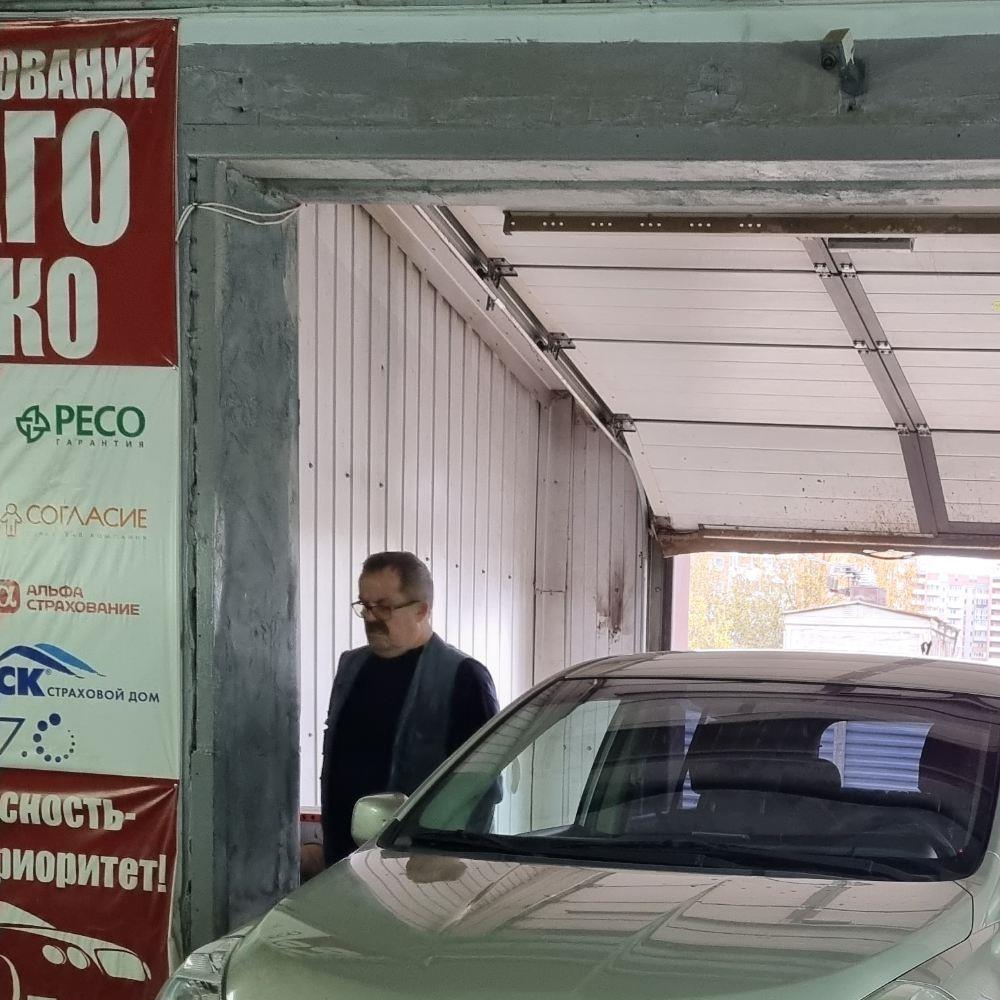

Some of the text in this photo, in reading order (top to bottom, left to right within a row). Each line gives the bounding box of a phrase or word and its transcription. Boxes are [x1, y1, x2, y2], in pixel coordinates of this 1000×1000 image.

[0, 47, 156, 100] ОВАНИЕ
[0, 107, 131, 247] ГО
[0, 256, 98, 359] КО
[55, 404, 146, 438] РЕСО
[56, 438, 144, 448] ГАРАНТИЯ
[26, 504, 148, 529] СОГЛАСИЕ
[26, 584, 84, 598] АЛЬФА
[26, 599, 140, 616] СТРАХОВАНИЕ
[0, 665, 160, 703] СК СТРАХОВОЙ ДОМ
